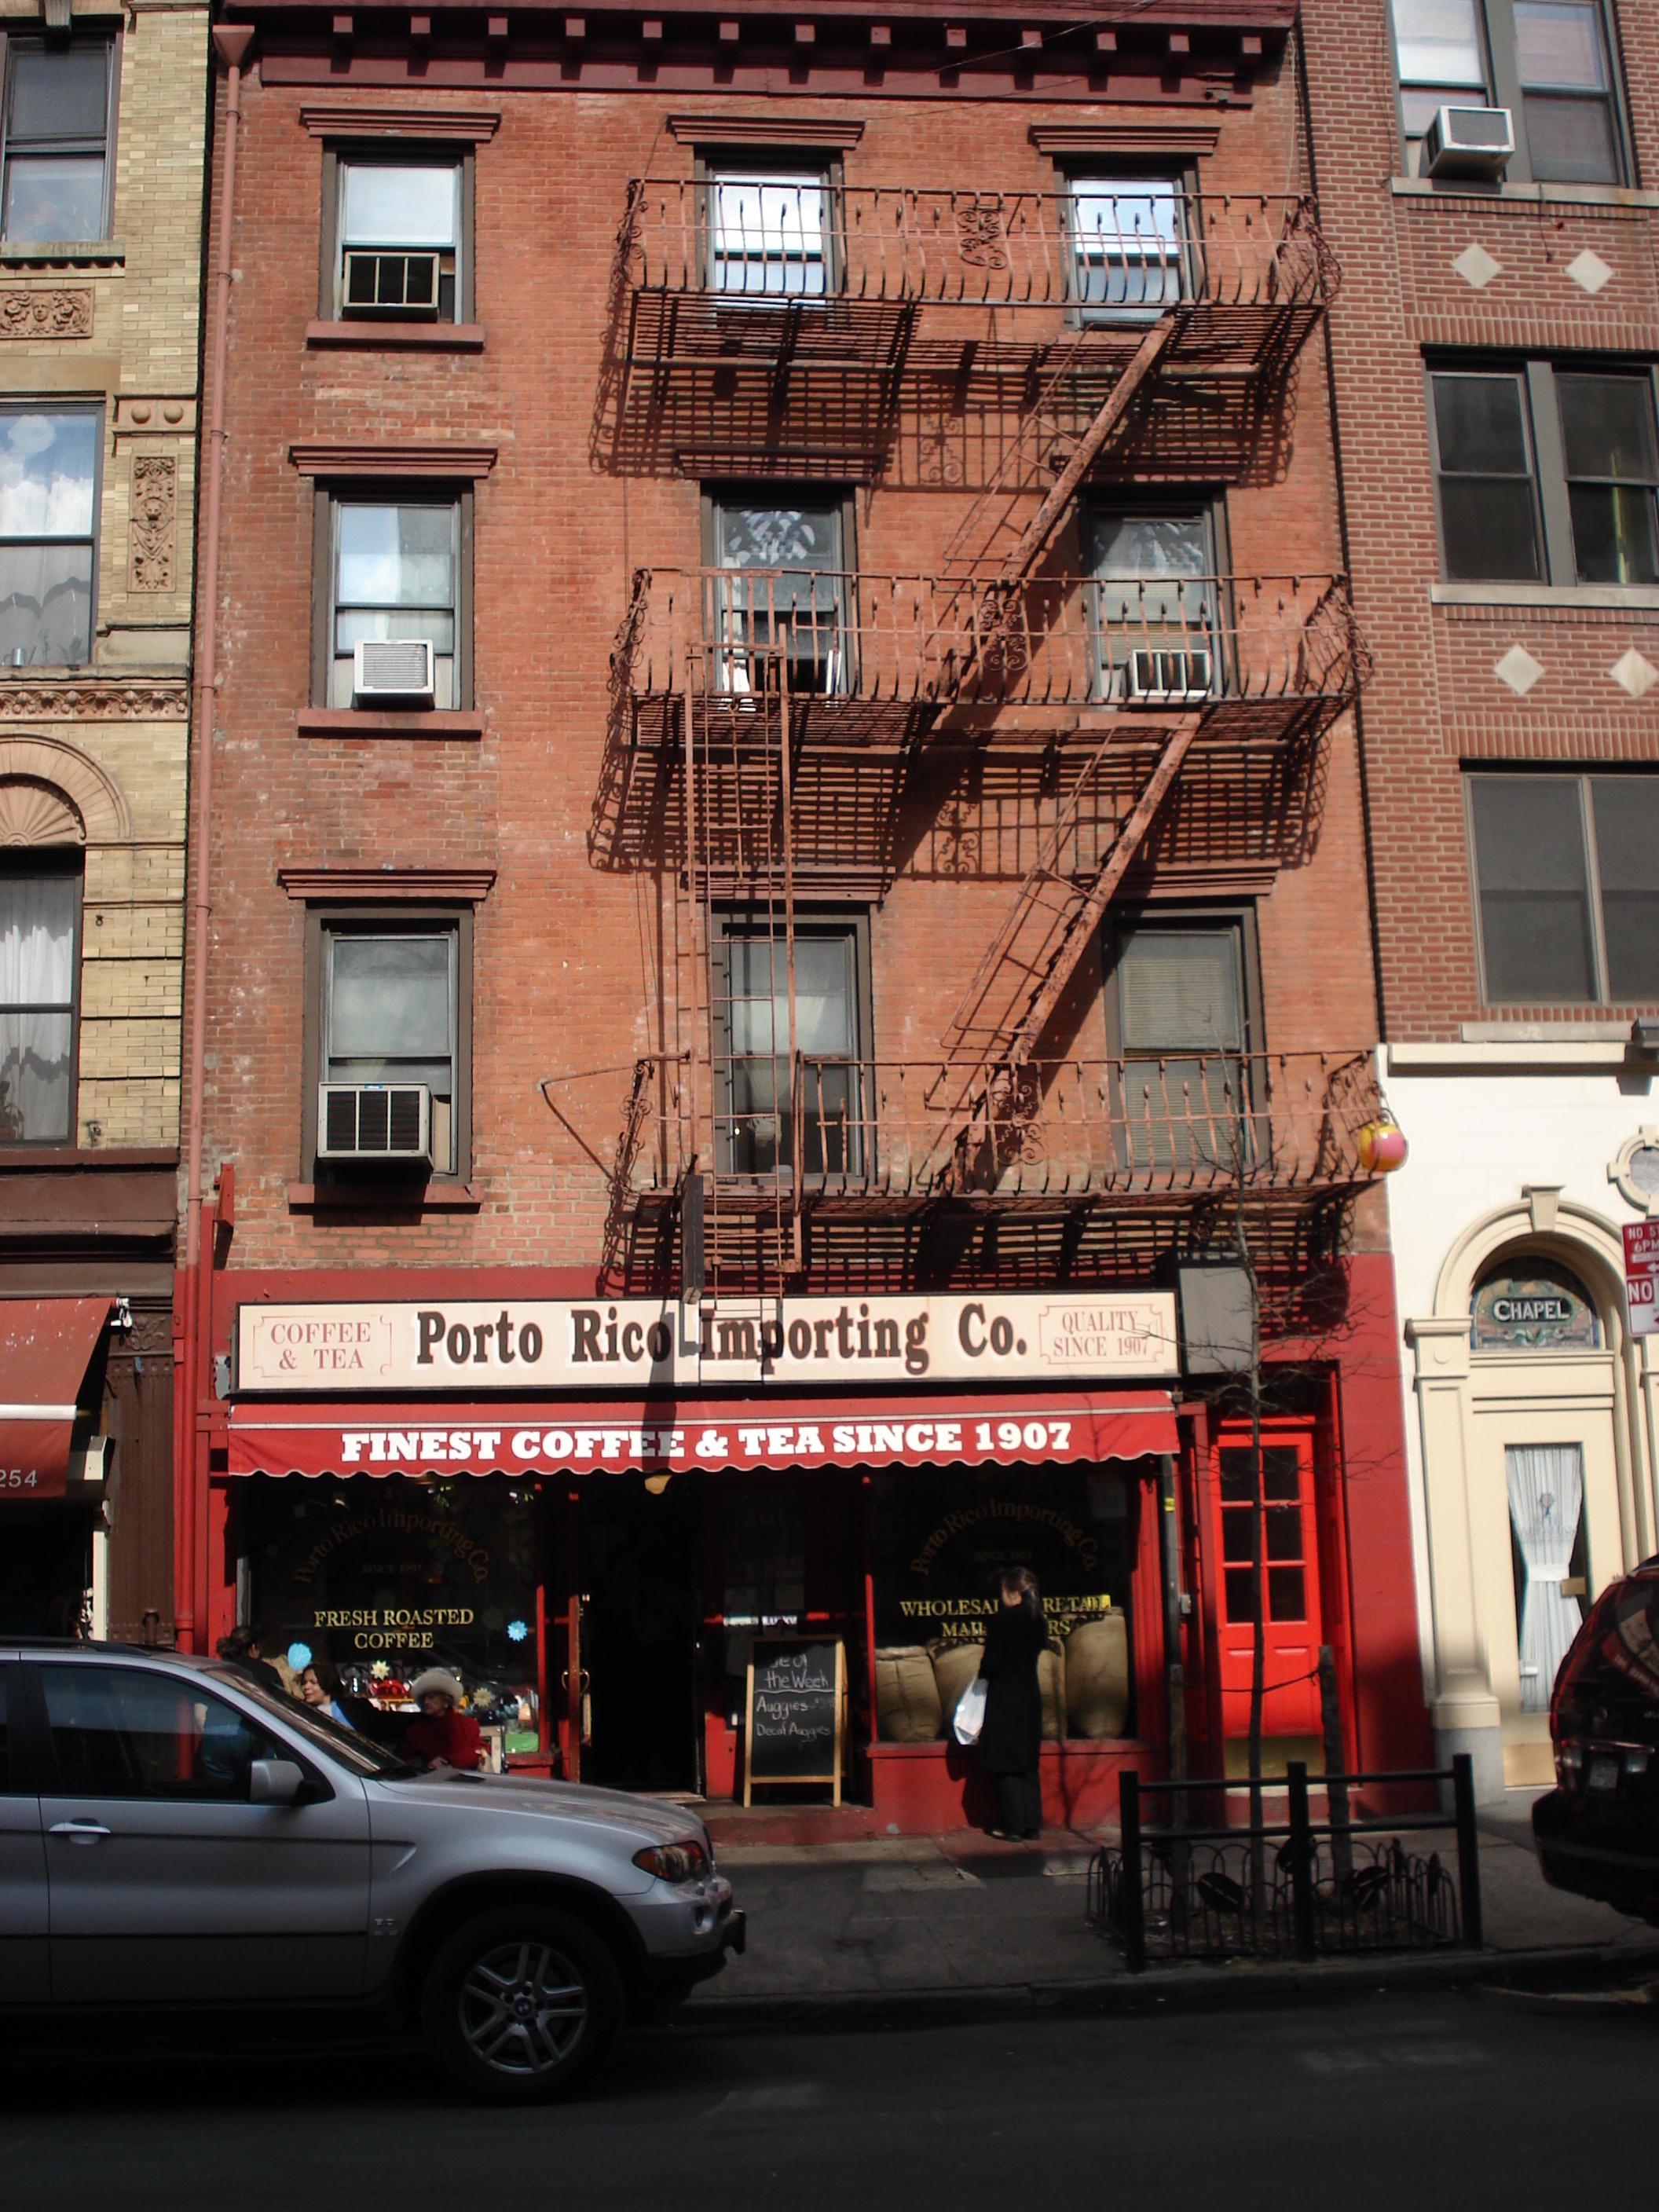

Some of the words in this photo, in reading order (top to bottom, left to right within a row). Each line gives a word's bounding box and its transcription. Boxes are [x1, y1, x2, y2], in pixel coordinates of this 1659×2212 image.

[1628, 1226, 1643, 1240] NO
[1628, 1280, 1652, 1303] NO
[1062, 1310, 1140, 1333] QUALITY
[1493, 1299, 1570, 1322] CHAPEL
[270, 1322, 372, 1345] COFFEE
[416, 1309, 544, 1365] Porto
[570, 1306, 672, 1364] Rico
[701, 1302, 929, 1375] Importing
[958, 1303, 1027, 1357] Co.
[1053, 1337, 1107, 1358] SINCE
[1117, 1336, 1149, 1357] 1907
[279, 1350, 298, 1370] &
[313, 1348, 365, 1370] TEA
[341, 1429, 502, 1463] FINEST
[511, 1429, 686, 1461] COFFEE
[695, 1429, 728, 1457] &
[738, 1426, 826, 1456] TEA
[833, 1423, 962, 1453] SINCE
[975, 1422, 1071, 1451] 1907
[293, 1538, 334, 1585] Porto
[330, 1515, 376, 1544] Rico
[379, 1507, 475, 1559] Importing
[910, 1529, 949, 1576] Porto
[943, 1505, 988, 1535] Rico
[989, 1497, 1084, 1548] Importing
[974, 1551, 1007, 1562] SINCE
[362, 1563, 394, 1574] SINCE
[314, 1610, 378, 1628] FRESH
[383, 1609, 474, 1626] ROASTED
[354, 1632, 434, 1650] COFFEE
[764, 1670, 791, 1689] the
[791, 1668, 829, 1689] Week
[756, 1696, 808, 1720] Auggies
[756, 1721, 786, 1736] Decaf
